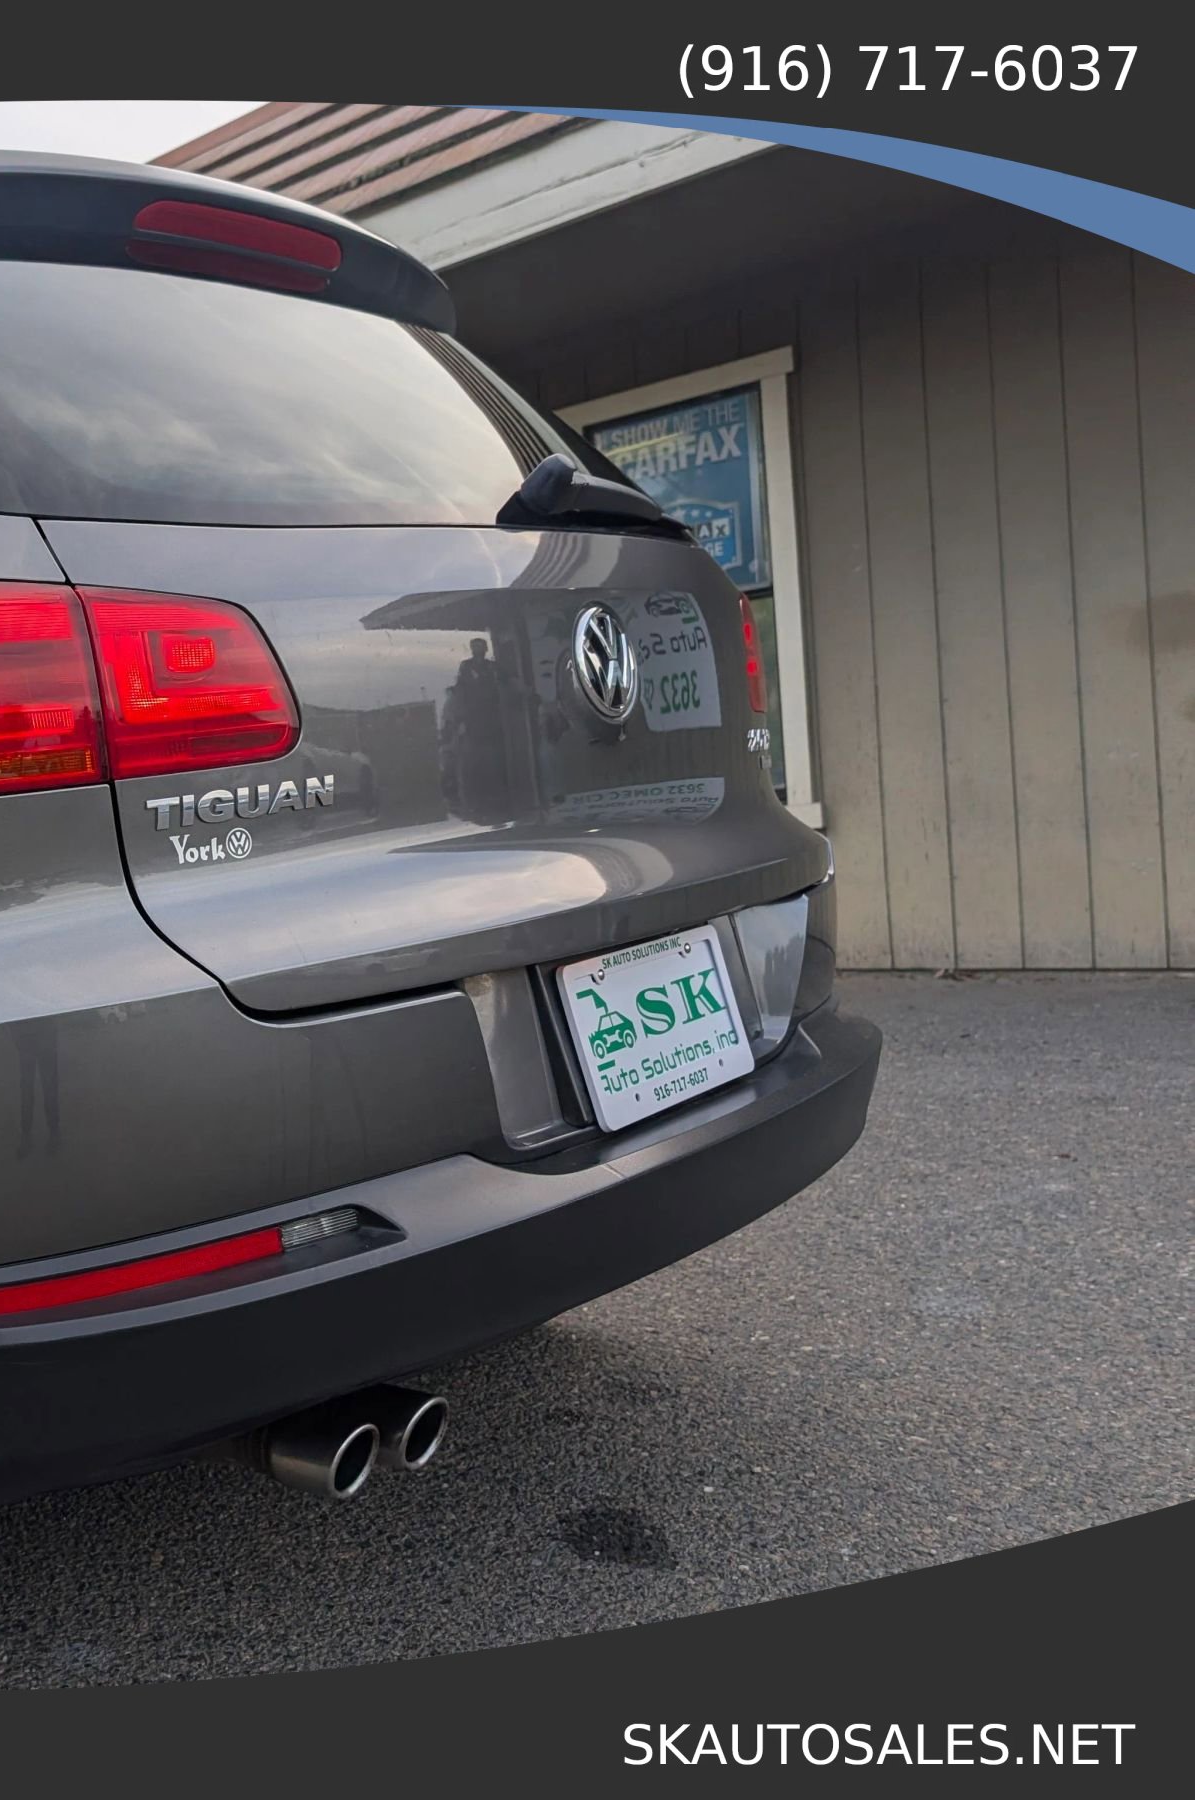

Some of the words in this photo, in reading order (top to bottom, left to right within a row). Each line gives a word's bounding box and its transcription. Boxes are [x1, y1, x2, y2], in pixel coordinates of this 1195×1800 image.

[611, 418, 668, 447] SHOW
[673, 412, 702, 436] ME
[706, 399, 740, 426] THE
[614, 424, 742, 479] CARFAX
[146, 774, 334, 831] TIGUAN
[169, 833, 226, 865] York
[601, 957, 613, 970] SK
[613, 952, 632, 968] AUTO
[632, 941, 670, 961] SOLUTIONS
[669, 936, 682, 949] INC
[635, 968, 727, 1039] SK
[653, 1067, 710, 1102] 916-717-6037
